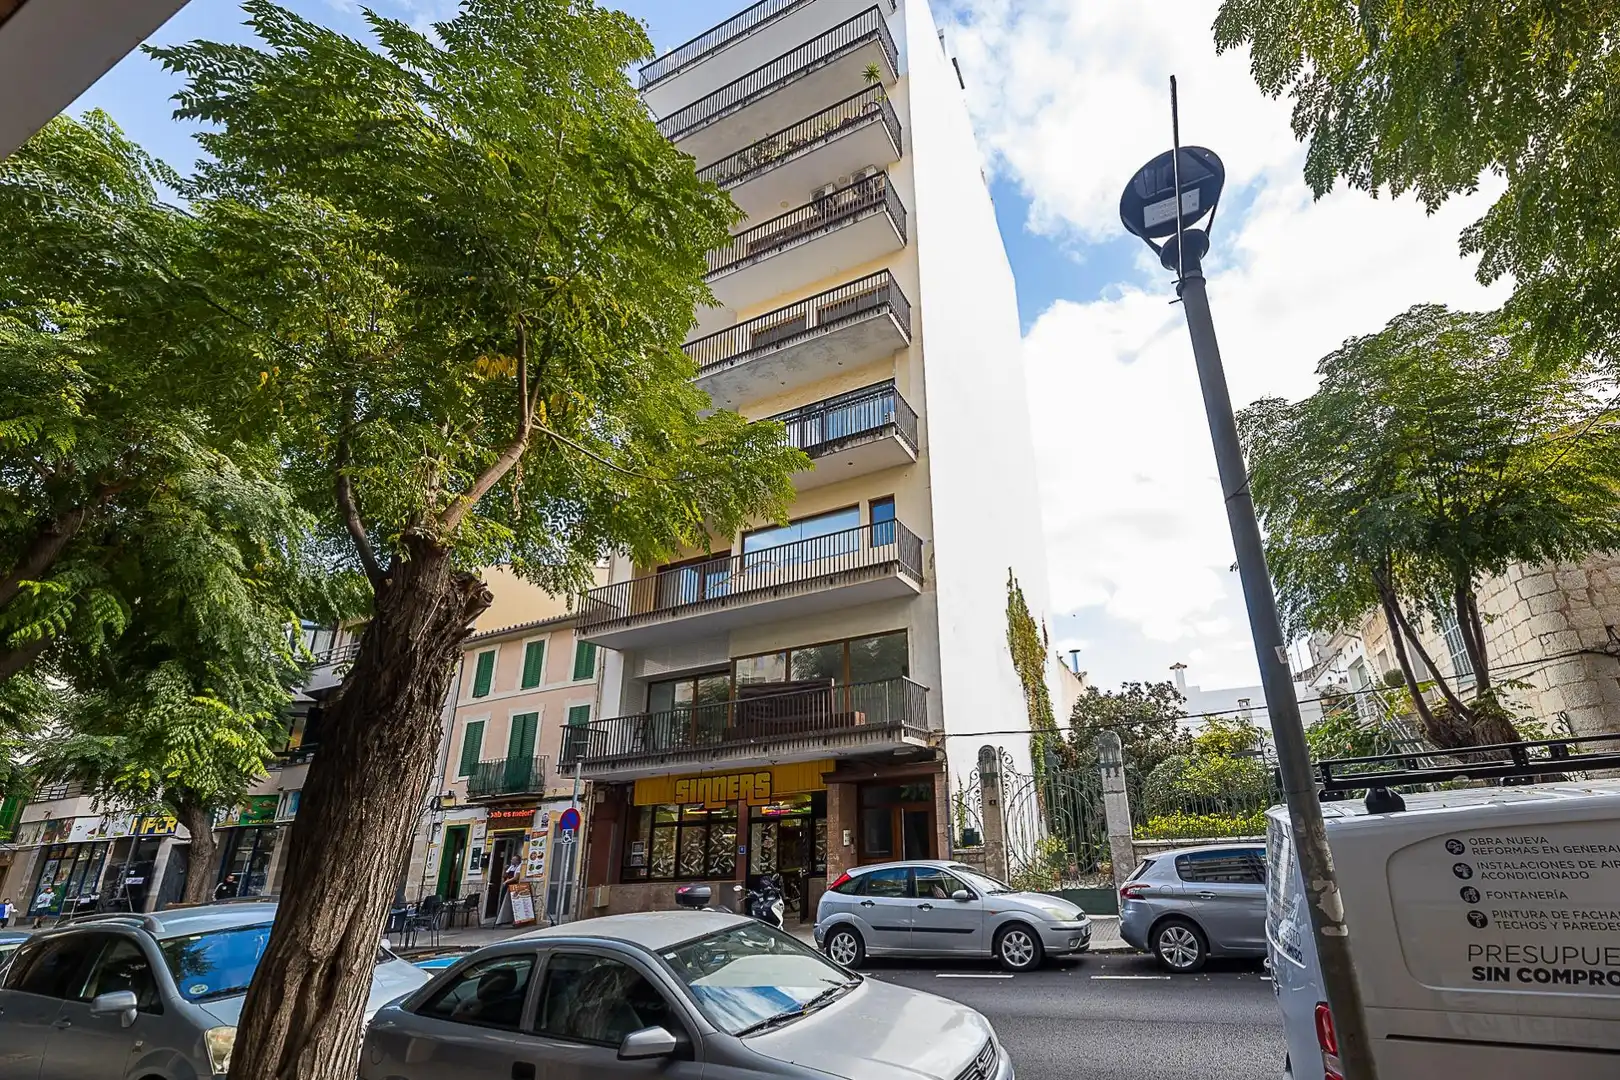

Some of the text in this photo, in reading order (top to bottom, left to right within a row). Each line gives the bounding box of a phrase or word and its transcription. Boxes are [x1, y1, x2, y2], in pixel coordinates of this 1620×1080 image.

[675, 772, 772, 810] SINNERS
[1468, 836, 1548, 846] OBRA NUEVA
[1472, 846, 1539, 855] REFORMAS
[1543, 846, 1560, 854] EN
[1476, 860, 1575, 870] INSTALACIONES
[1578, 860, 1597, 869] DE
[1480, 871, 1590, 880] ACONDICIONADO
[1485, 889, 1569, 900] FONTANERÍA
[1491, 910, 1549, 919] PINTURA
[1551, 910, 1570, 920] DE
[1494, 920, 1620, 931] TECHOS Y PAREDES
[1467, 944, 1620, 967] PRESUPUE
[1471, 966, 1620, 987] SIN COMPRO
